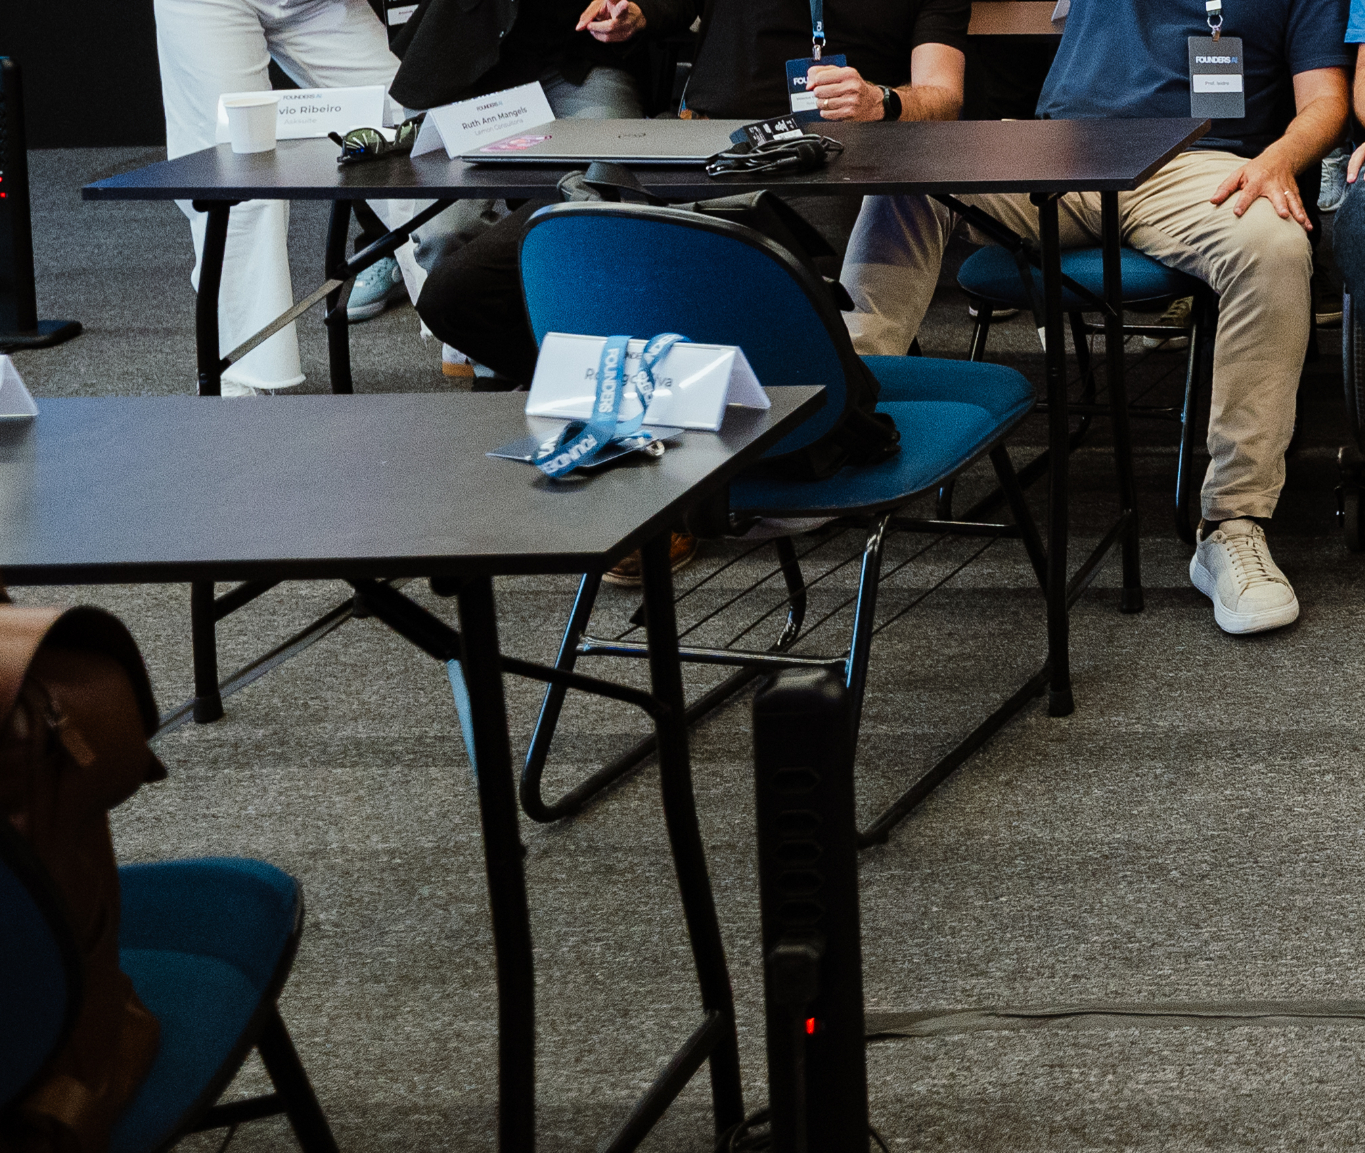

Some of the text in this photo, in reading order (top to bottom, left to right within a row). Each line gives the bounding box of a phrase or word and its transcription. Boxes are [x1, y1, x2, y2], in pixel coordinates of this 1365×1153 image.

[1195, 56, 1238, 64] FOUNDERS AI
[300, 104, 342, 114] Ribeiro
[462, 107, 528, 130] Ruth Ann Mangels
[475, 126, 494, 136] Lemon
[599, 349, 620, 413] FOUNDERS
